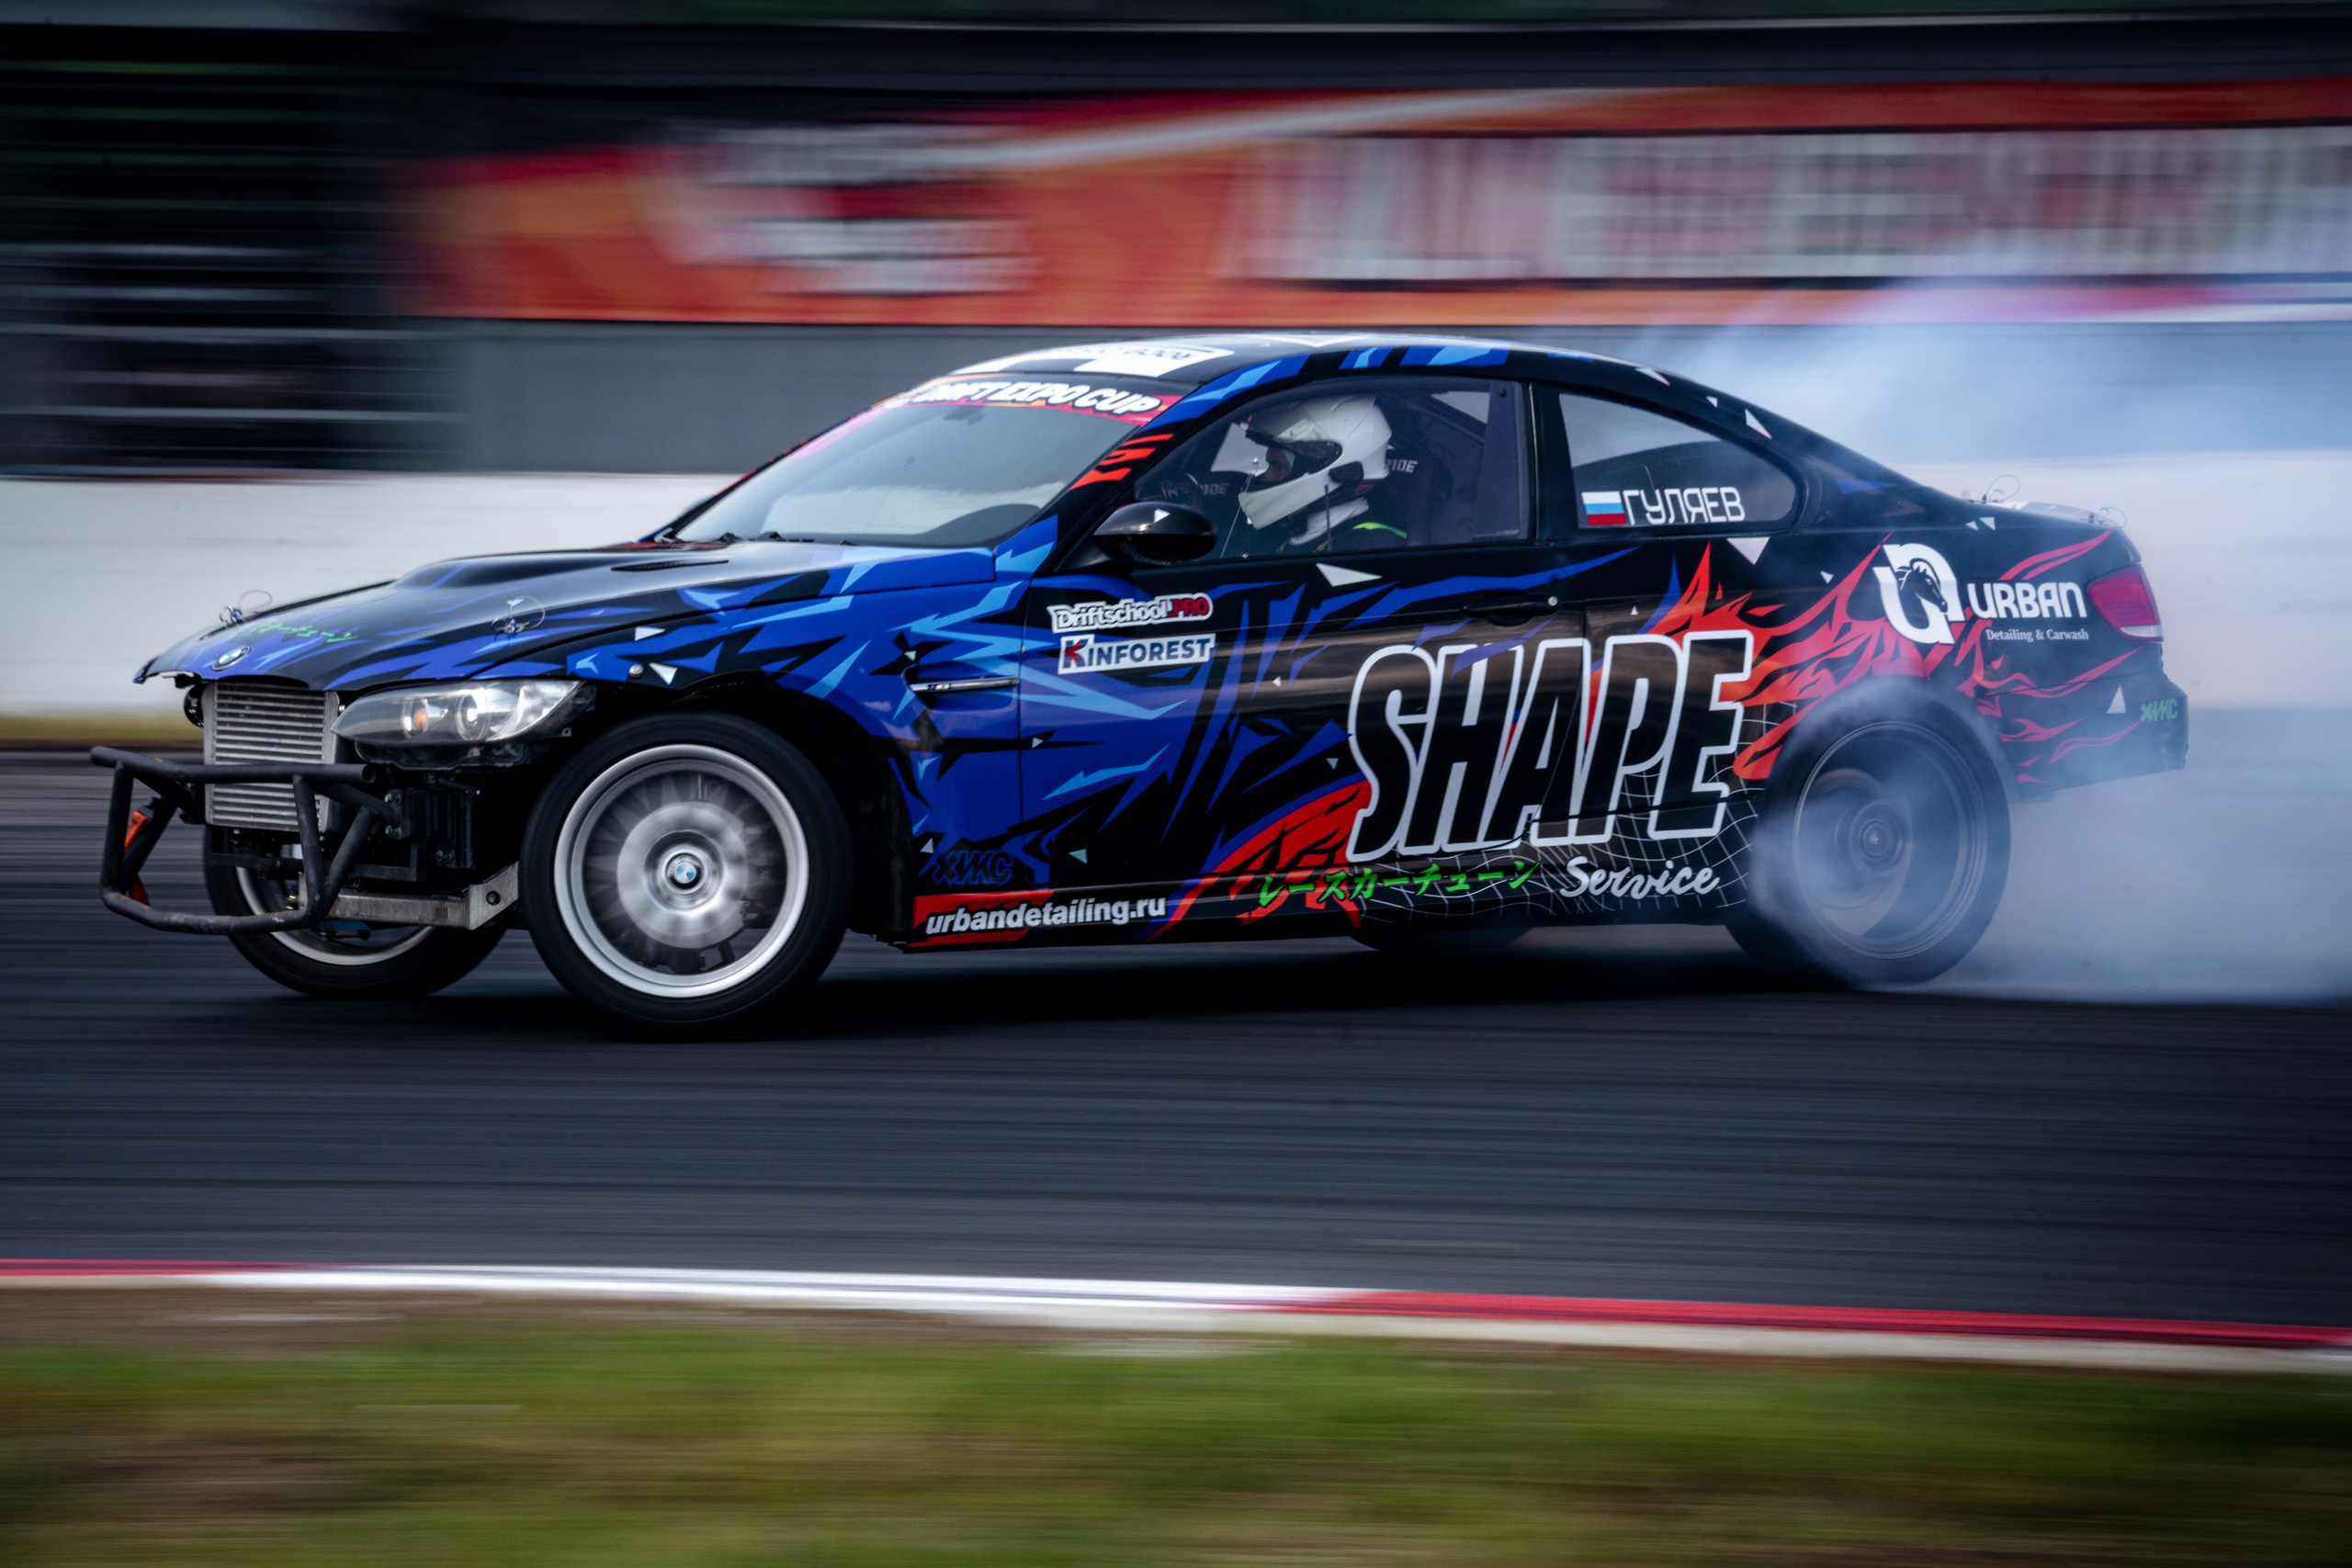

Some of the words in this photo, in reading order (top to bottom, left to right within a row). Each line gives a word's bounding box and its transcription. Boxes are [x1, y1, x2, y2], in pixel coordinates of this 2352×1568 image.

[986, 381, 1091, 404] EXPO
[1074, 388, 1161, 414] CUP
[1623, 486, 1746, 525] ГУЛЯЕВ
[1057, 596, 1210, 629] Driftschool.PRO
[1967, 581, 2087, 619] URBAN
[1062, 637, 1212, 669] KINFOREST
[1985, 628, 2033, 642] Detailing
[2036, 629, 2044, 640] &
[2046, 628, 2089, 640] Carwash
[1345, 629, 1754, 863] SHAPE
[1259, 859, 1542, 908] レースカーチューン
[1561, 855, 1721, 898] Service
[925, 897, 1167, 936] urbandetailing.ru
